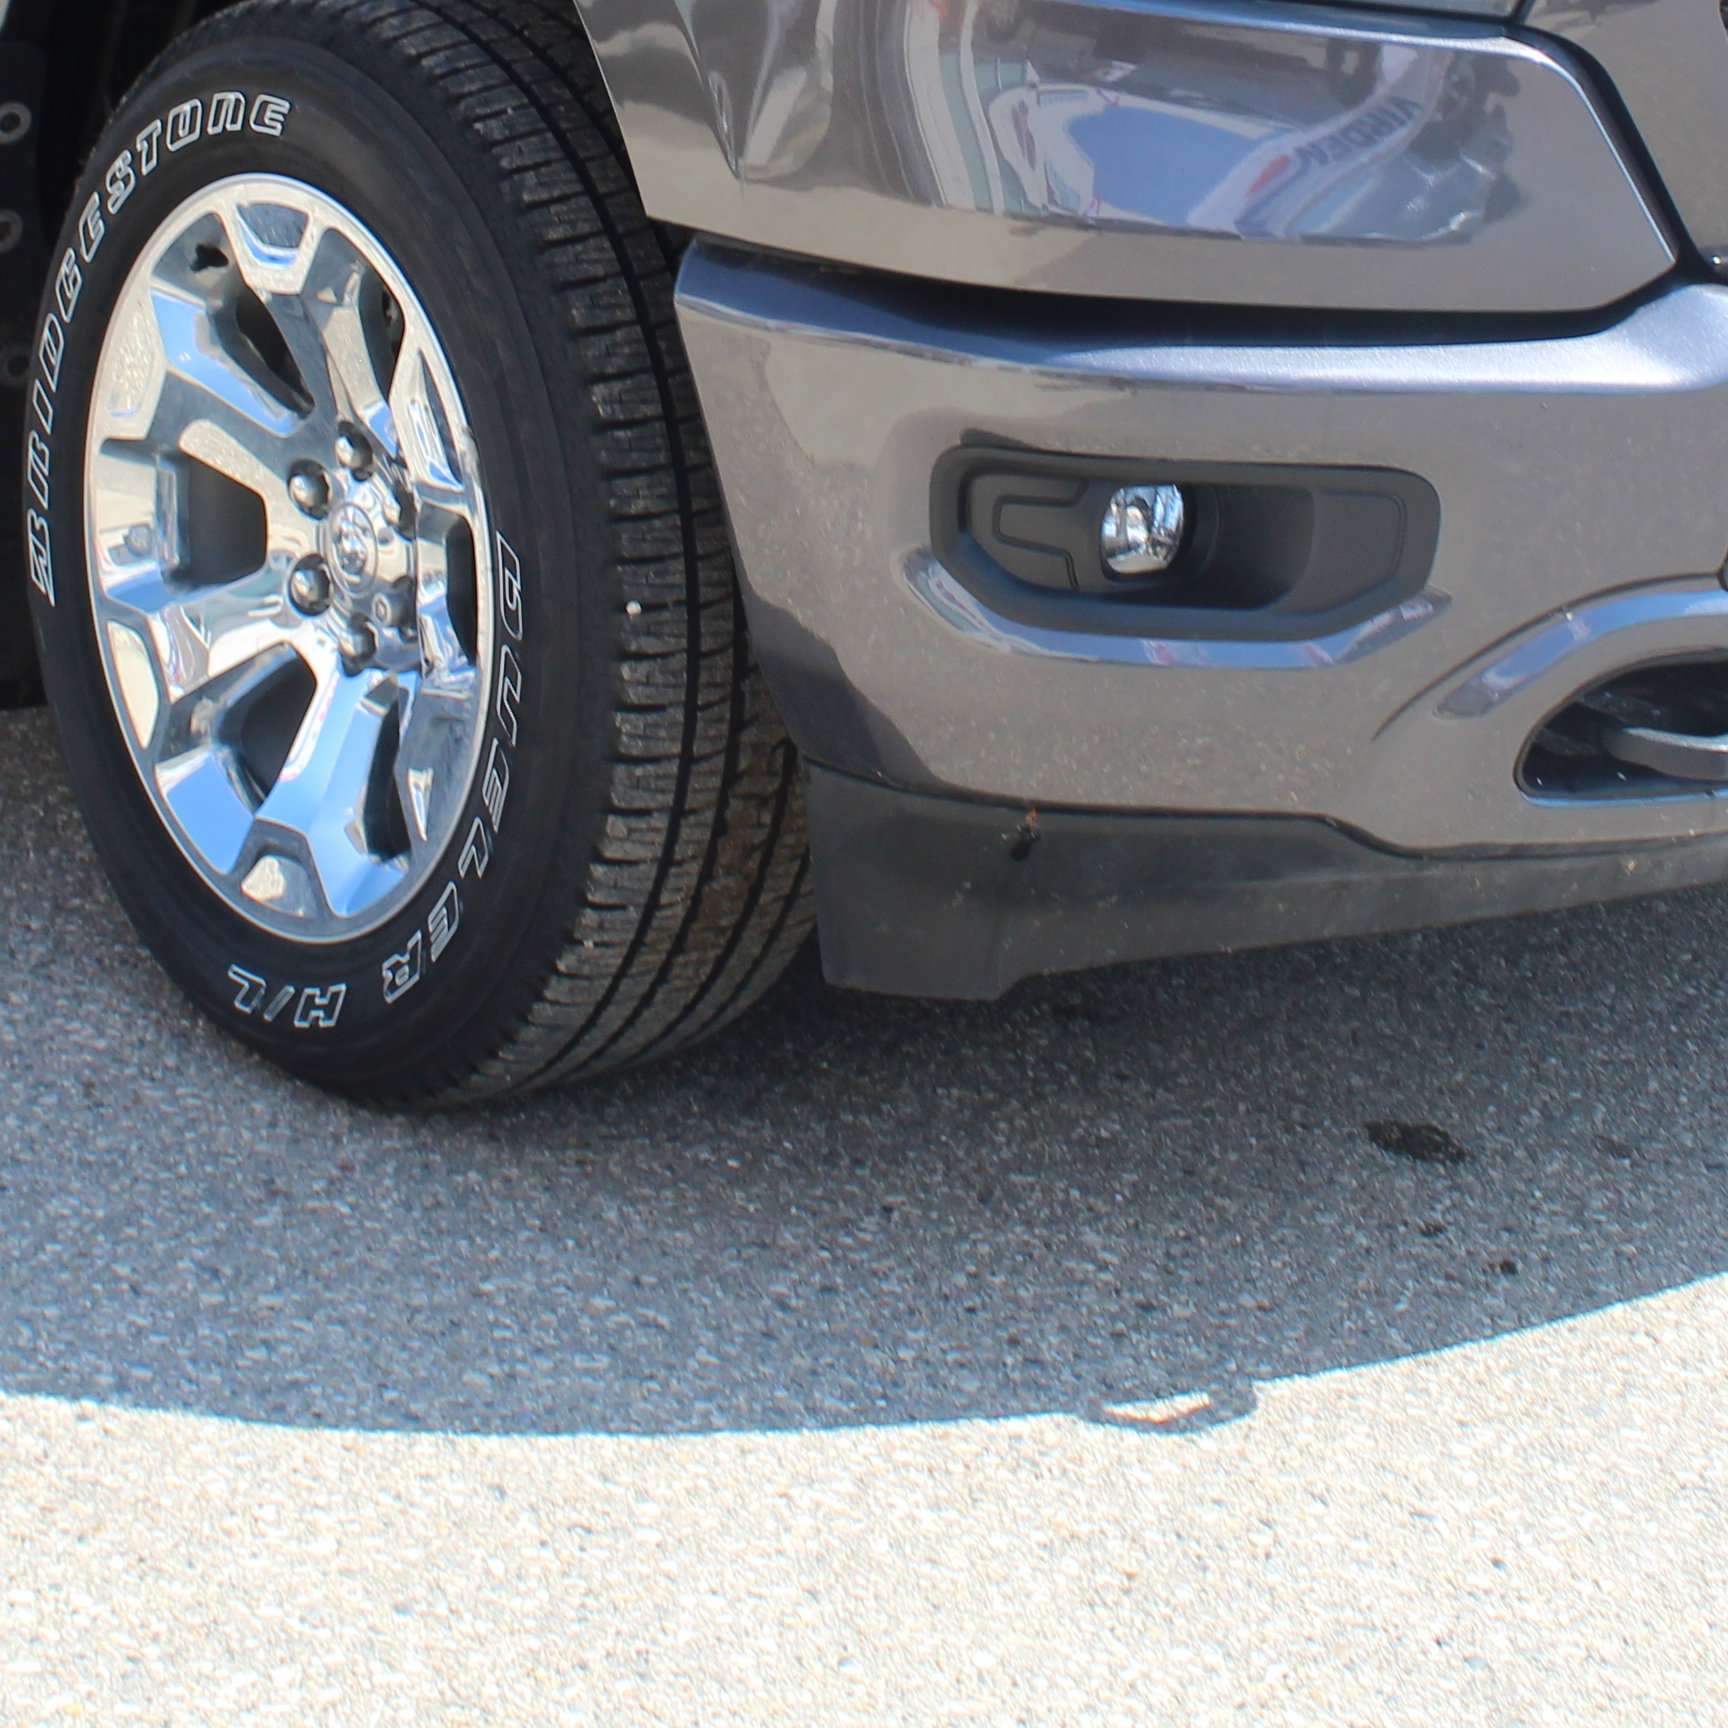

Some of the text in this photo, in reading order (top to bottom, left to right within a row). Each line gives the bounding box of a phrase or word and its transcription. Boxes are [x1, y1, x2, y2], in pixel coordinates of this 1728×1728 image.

[25, 91, 291, 607] BRIDGESTONE
[227, 530, 524, 1029] DUELER H/L
